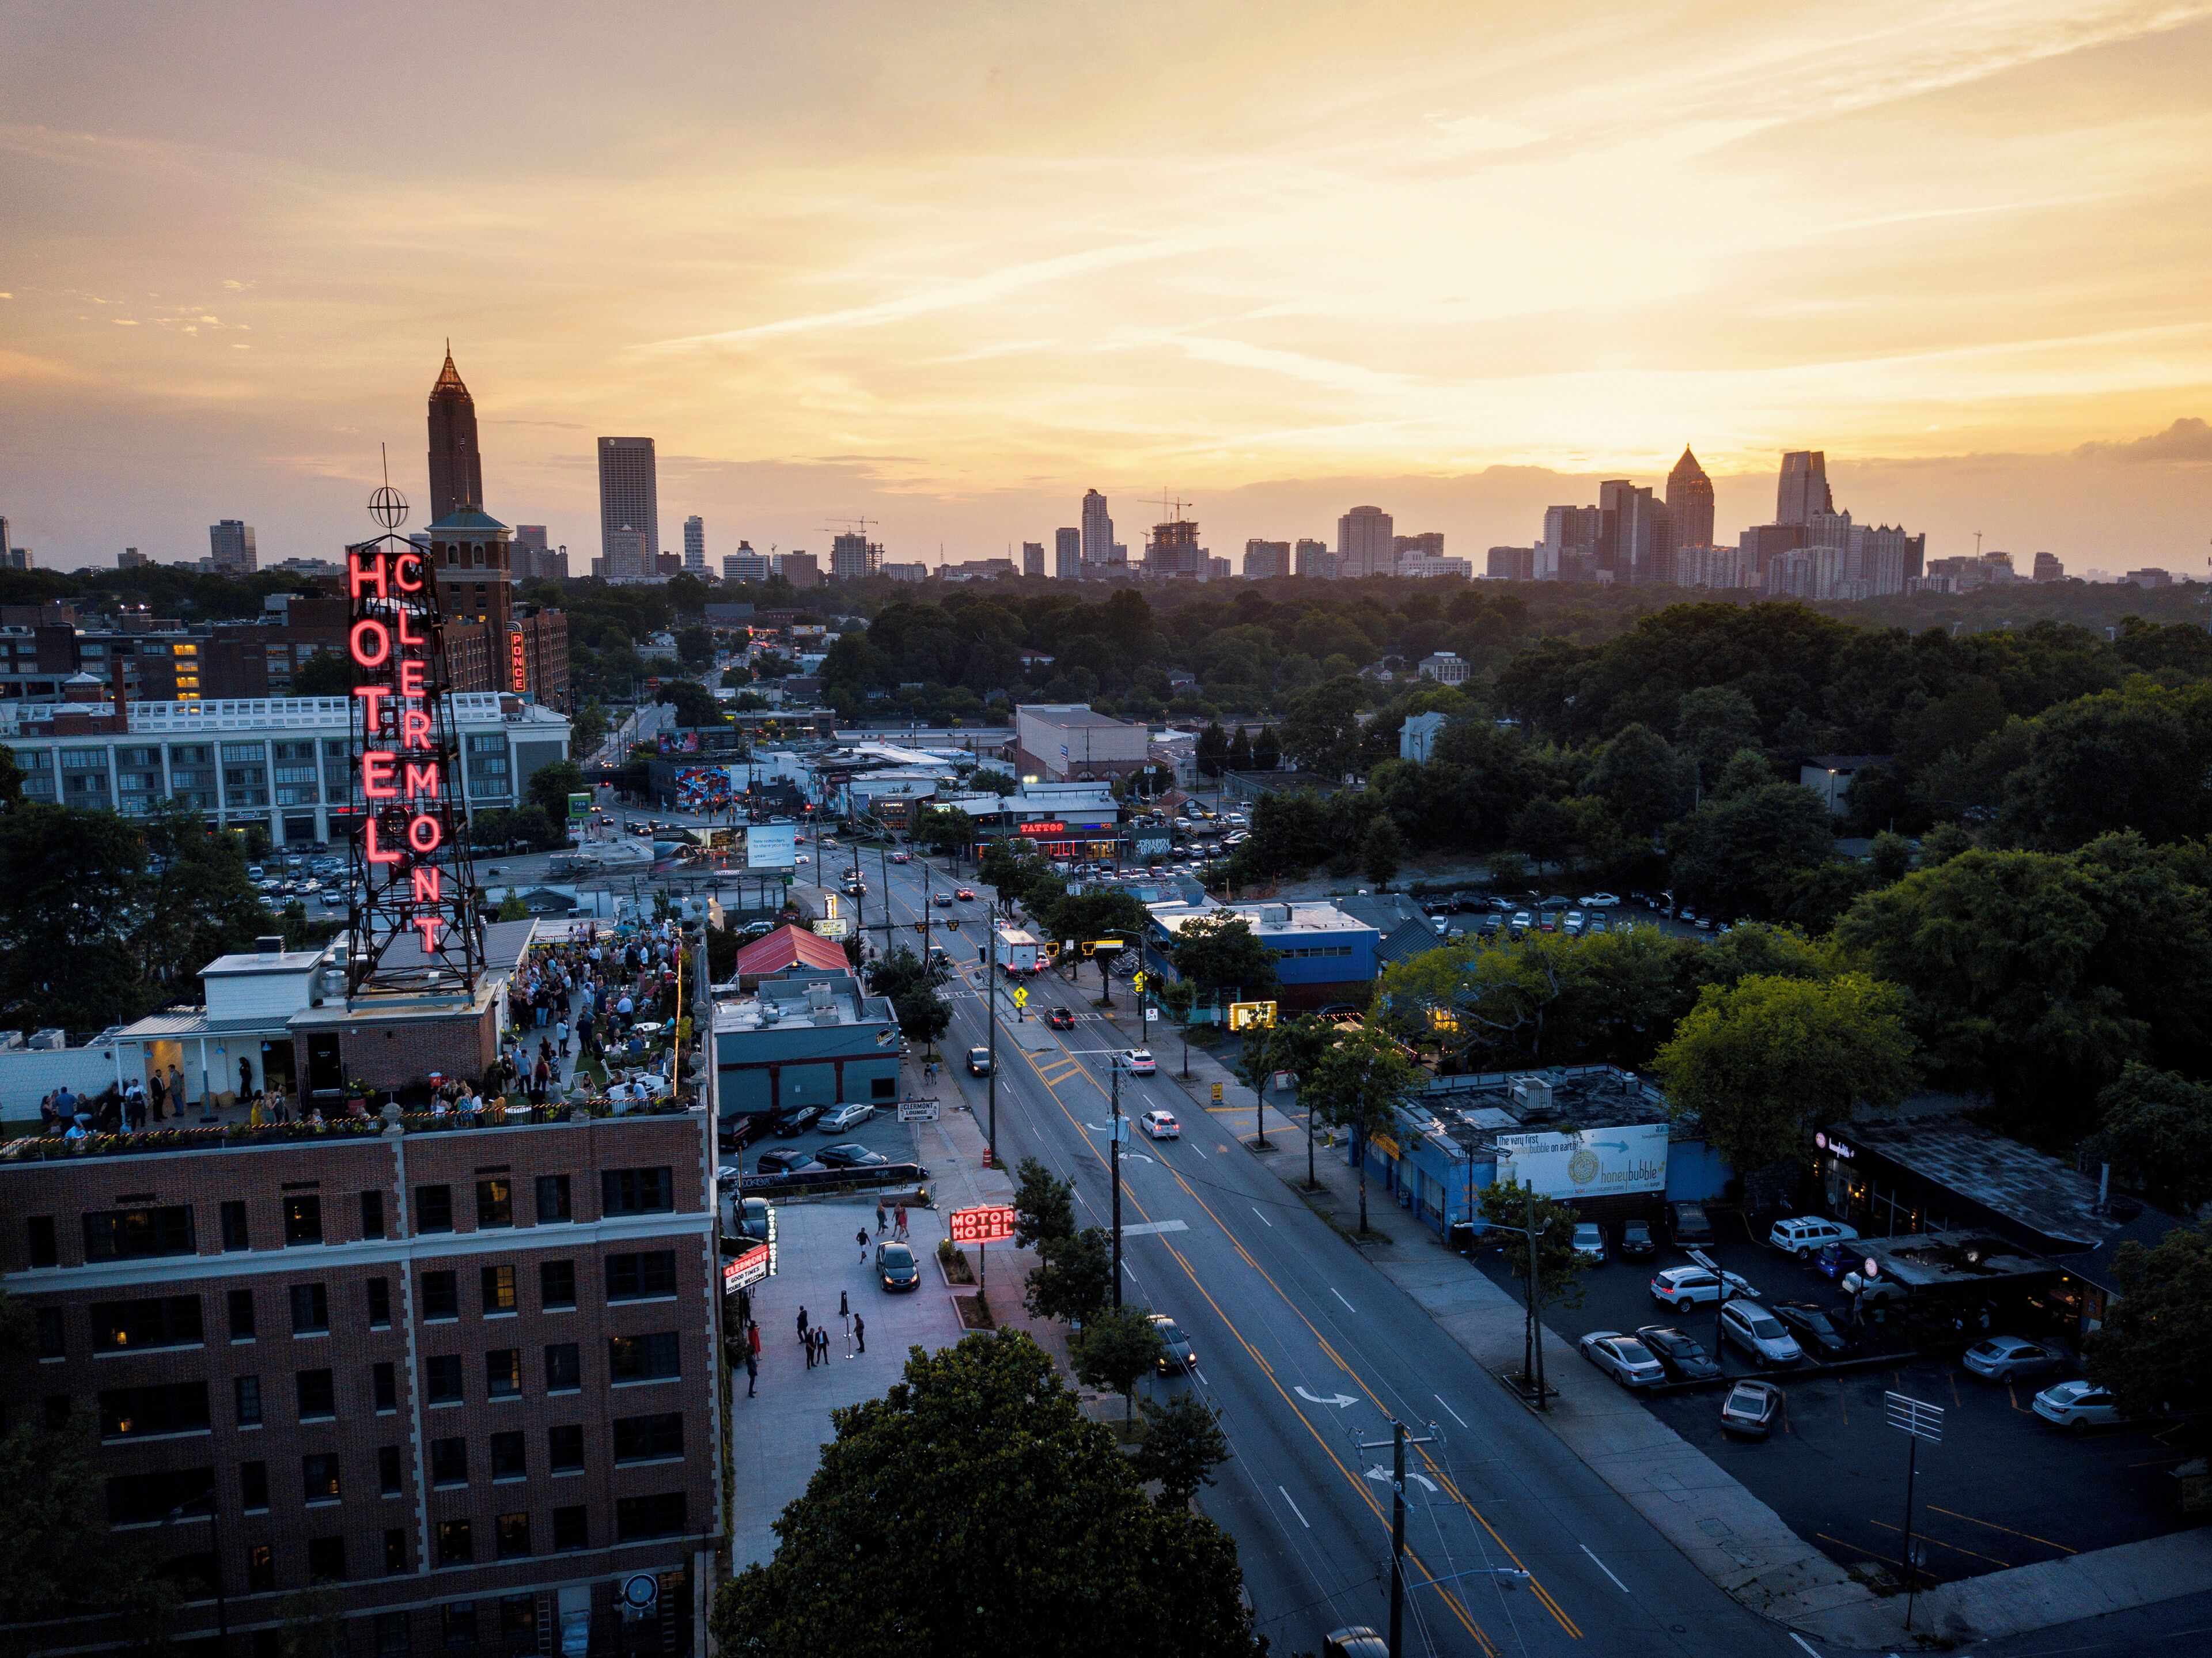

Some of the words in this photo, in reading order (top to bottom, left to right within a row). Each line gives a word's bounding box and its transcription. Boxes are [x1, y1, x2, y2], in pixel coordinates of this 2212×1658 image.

[513, 635, 523, 688] PONCE
[350, 554, 400, 862] HOTEL
[395, 554, 441, 953] CLERMONT
[1020, 823, 1063, 832] TATTOO
[1499, 1137, 1509, 1146] The
[1510, 1137, 1524, 1147] very
[1525, 1135, 1539, 1144] first
[1551, 1144, 1558, 1152] on
[1601, 1159, 1657, 1191] honeybubble
[767, 1209, 776, 1241] MOTOR
[952, 1211, 1014, 1227] MOTOR
[953, 1223, 1013, 1239] HOTEL
[725, 1251, 768, 1277] CLERMONT
[769, 1243, 777, 1276] HOTEL
[727, 1282, 741, 1293] YOURE
[744, 1271, 766, 1285] WELCOME
[731, 1273, 744, 1283] GOOD
[744, 1266, 760, 1277] TIMES
